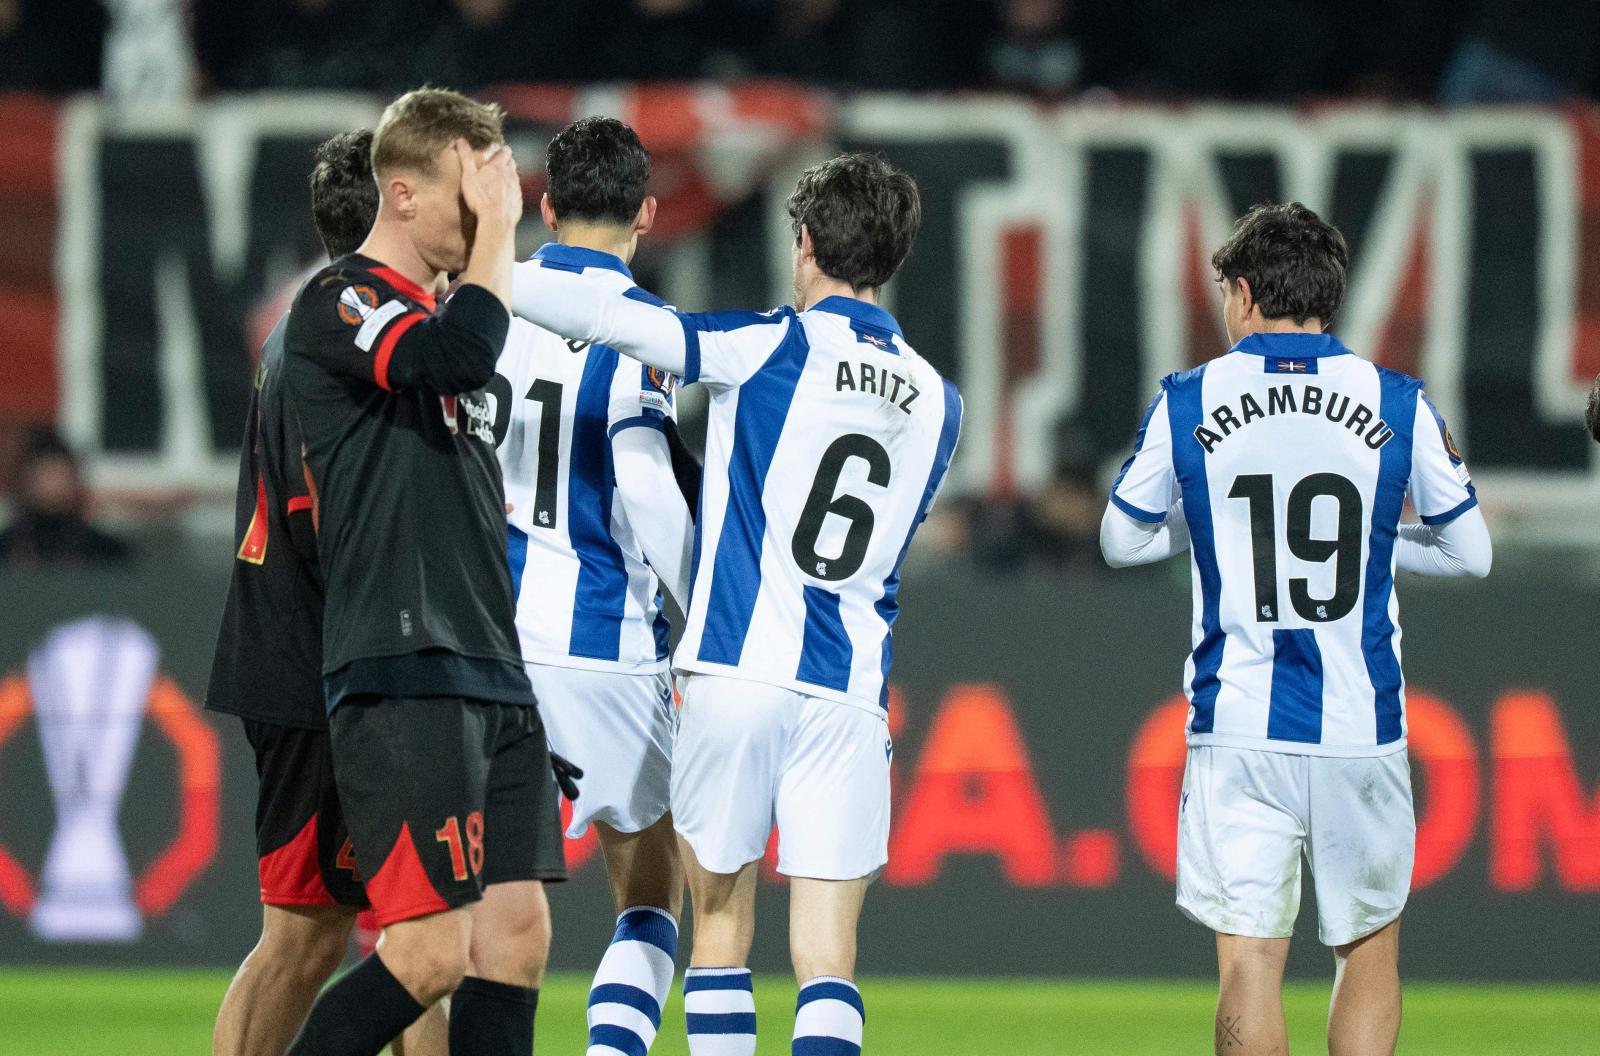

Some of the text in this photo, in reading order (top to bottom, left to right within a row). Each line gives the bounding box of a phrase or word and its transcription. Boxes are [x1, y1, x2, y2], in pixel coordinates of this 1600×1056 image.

[836, 361, 920, 415] ARITZ
[1193, 384, 1394, 454] ARAMBURU
[791, 433, 891, 582] 6
[1227, 472, 1363, 623] 19
[435, 811, 485, 881] 18
